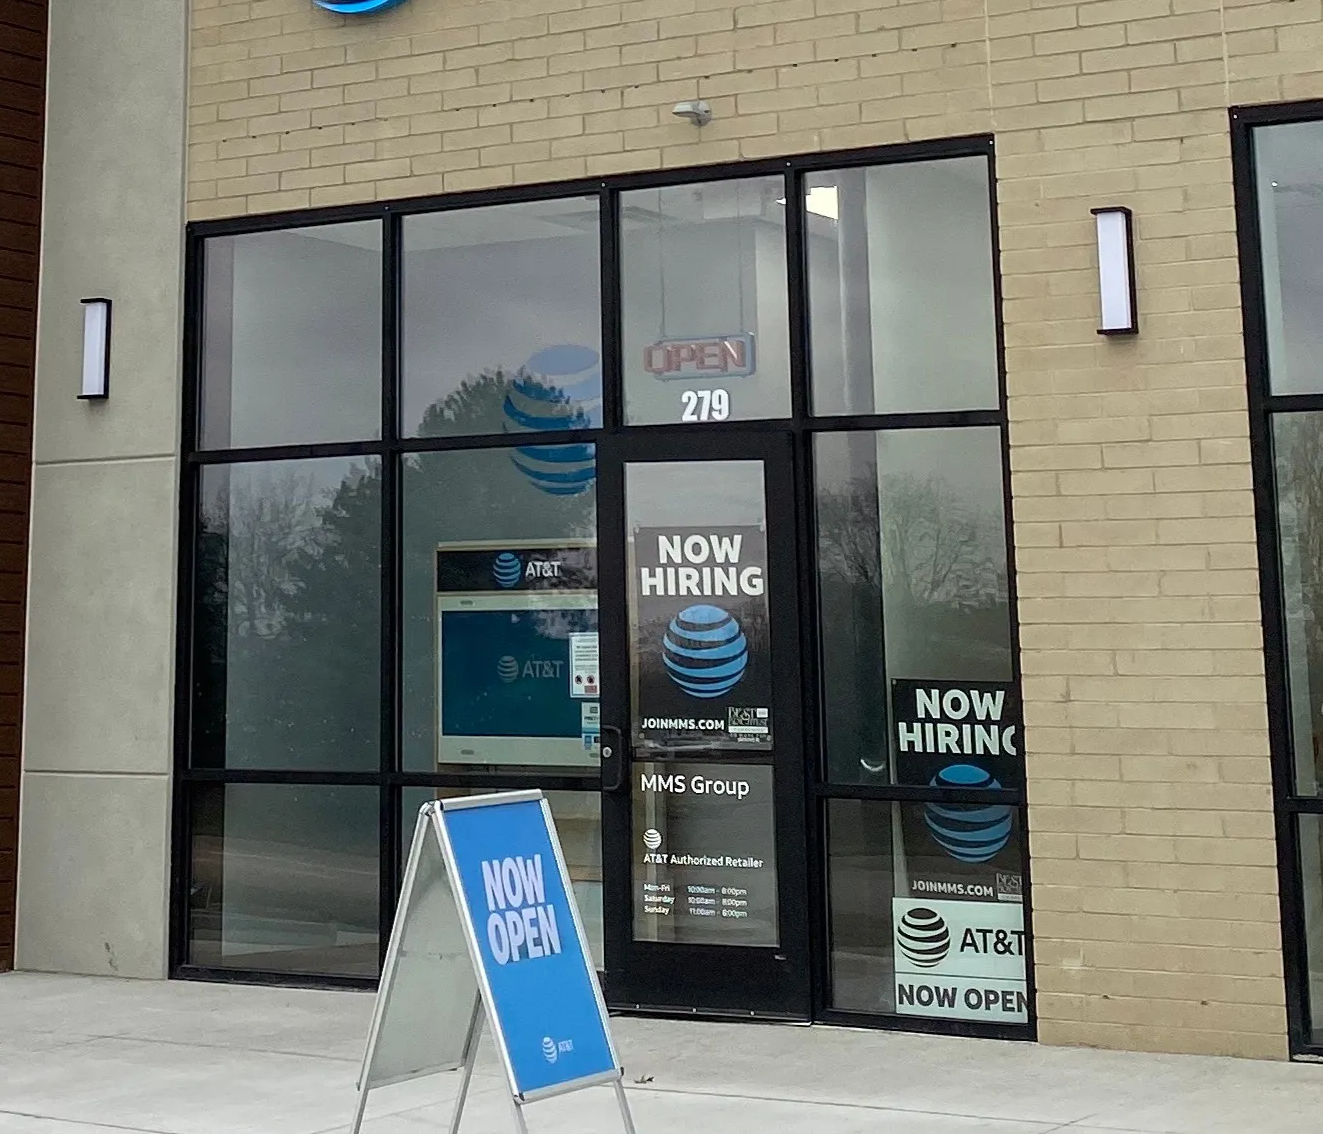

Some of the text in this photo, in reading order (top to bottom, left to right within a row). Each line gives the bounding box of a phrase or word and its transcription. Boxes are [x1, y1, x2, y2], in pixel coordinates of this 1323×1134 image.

[643, 339, 746, 374] OPEN
[681, 389, 730, 421] 279
[658, 534, 742, 564] NOW
[525, 561, 561, 577] AT&T
[640, 566, 765, 597] HIRING
[522, 660, 564, 678] AT&T
[916, 689, 1005, 720] NOW
[641, 718, 725, 731] JOINMMS.COM
[641, 774, 750, 800] MMS Group
[643, 854, 764, 868] AT&T Authorized Retailer
[481, 853, 546, 911] NOW
[912, 880, 994, 897] JOINMMS.COM
[487, 904, 562, 965] OPEN
[960, 928, 1025, 956] AT&T
[898, 983, 957, 1008] NOW
